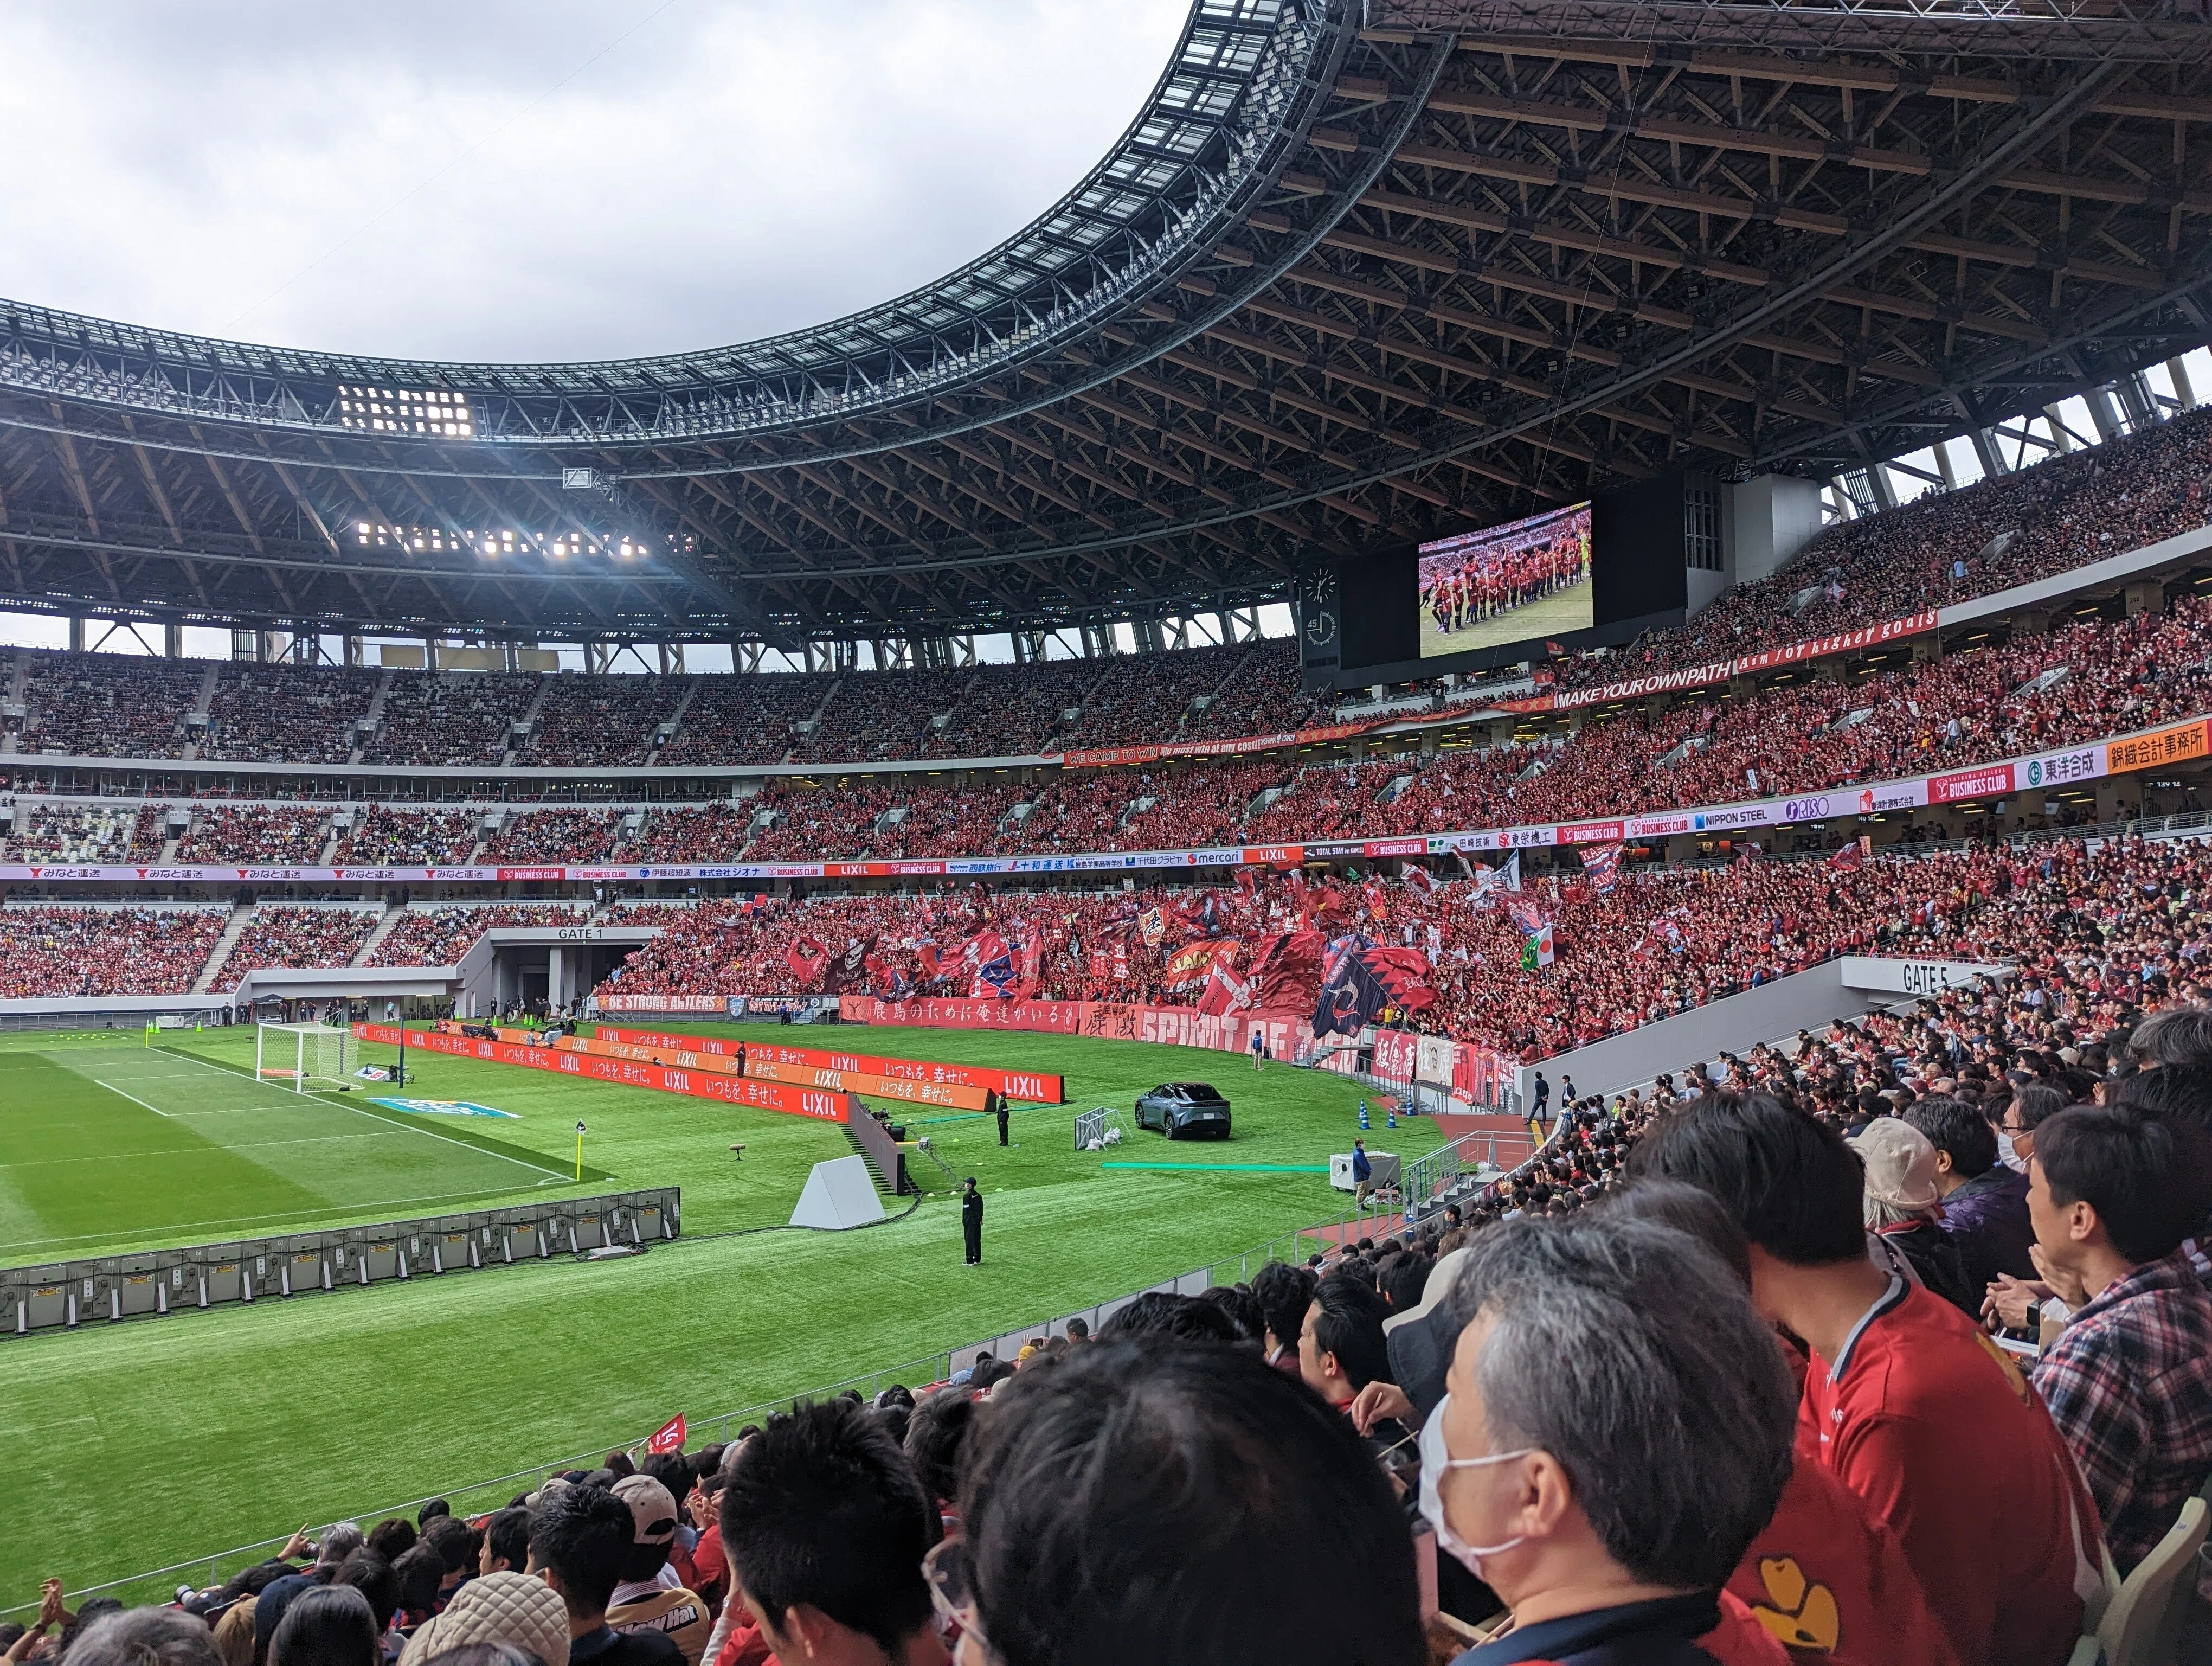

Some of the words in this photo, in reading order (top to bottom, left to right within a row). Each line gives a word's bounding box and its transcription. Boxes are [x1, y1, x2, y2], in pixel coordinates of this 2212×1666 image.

[1308, 619, 1317, 627] 45
[1739, 653, 1768, 669] Aim
[1811, 627, 1875, 654] higher
[1881, 609, 1937, 638] goals
[1559, 687, 1602, 708] MAKE
[1602, 678, 1644, 699] YOUR
[1645, 670, 1687, 691] OWN
[1686, 661, 1732, 685] PATH
[1173, 746, 1193, 754] must
[1194, 744, 1210, 753] win
[1211, 744, 1220, 753] at
[1221, 743, 1236, 753] any
[1237, 739, 1261, 751] cost!!
[2111, 727, 2203, 769] 錦織会計事務所
[1068, 752, 1086, 764] WE
[1088, 750, 1119, 763] CAME
[1121, 749, 1135, 760] TO
[1137, 747, 1158, 759] WIN
[2045, 750, 2094, 781] 東洋合成
[1949, 779, 1985, 798] BUSINESS
[1987, 774, 2007, 792] CLUB
[1798, 797, 1829, 819] RISO
[1706, 813, 1738, 826] NIPPON
[1740, 809, 1768, 821] STEEL
[1573, 830, 1603, 841] BUSINESS
[1603, 828, 1618, 838] CLUB
[1642, 823, 1671, 835] BUSINESS
[1673, 820, 1688, 831] CLUB
[1459, 837, 1490, 848] 田崎技術
[1512, 831, 1551, 847] 東栄機工
[1199, 851, 1238, 863] mercari
[1259, 849, 1287, 860] LIXIL
[1380, 845, 1408, 855] BUSINESS
[1410, 844, 1422, 853] CLUB
[969, 863, 1002, 872] 西鉄旅行
[1021, 860, 1063, 870] 十和運送
[1137, 855, 1182, 865] 千代田グラビヤ
[44, 868, 100, 877] みなと運送
[150, 869, 203, 879] みなと運送
[250, 870, 300, 879] みなと運送
[346, 870, 394, 879] みなと運送
[437, 870, 483, 879] みなと運送
[652, 868, 691, 876] 伊藤超短波
[841, 864, 869, 874] LIXIL
[559, 929, 592, 939] GATE
[597, 929, 602, 939] 1
[1904, 964, 1937, 994] GATE
[1941, 966, 1947, 987] 5
[609, 995, 623, 1010] BE
[626, 995, 667, 1010] STRONG
[670, 995, 716, 1010] ANTLERS
[872, 1000, 1058, 1025] 鹿島のために俺達がいる
[1141, 1010, 1240, 1052] SPIRIT
[1244, 1020, 1288, 1060] OF
[356, 1024, 367, 1037] LIXIL
[412, 1033, 425, 1047] LIXIL
[432, 1036, 470, 1054] いつもを、幸せに。
[478, 1042, 494, 1058] LIXIL
[504, 1048, 549, 1067] いつもを、幸せに。
[560, 1054, 580, 1072] LIXIL
[591, 1060, 650, 1085] いつもを、幸せに。
[665, 1071, 690, 1090] LIXIL
[706, 1078, 783, 1108] いつもを、幸せに。
[802, 1092, 837, 1117] LIXIL
[572, 1038, 588, 1052] LIXIL
[609, 1044, 650, 1060] いつもを、幸せに。
[676, 1051, 697, 1067] LIXIL
[725, 1059, 778, 1079] いつを、幸せに。
[814, 1069, 841, 1088] LIXIL
[880, 1080, 953, 1104] いつもを、幸せに。
[602, 1030, 620, 1042] LIXIL
[703, 1040, 724, 1055] LIXIL
[831, 1055, 859, 1073] LIXIL
[1005, 1075, 1044, 1098] LIXIL
[661, 1422, 679, 1445] 14
